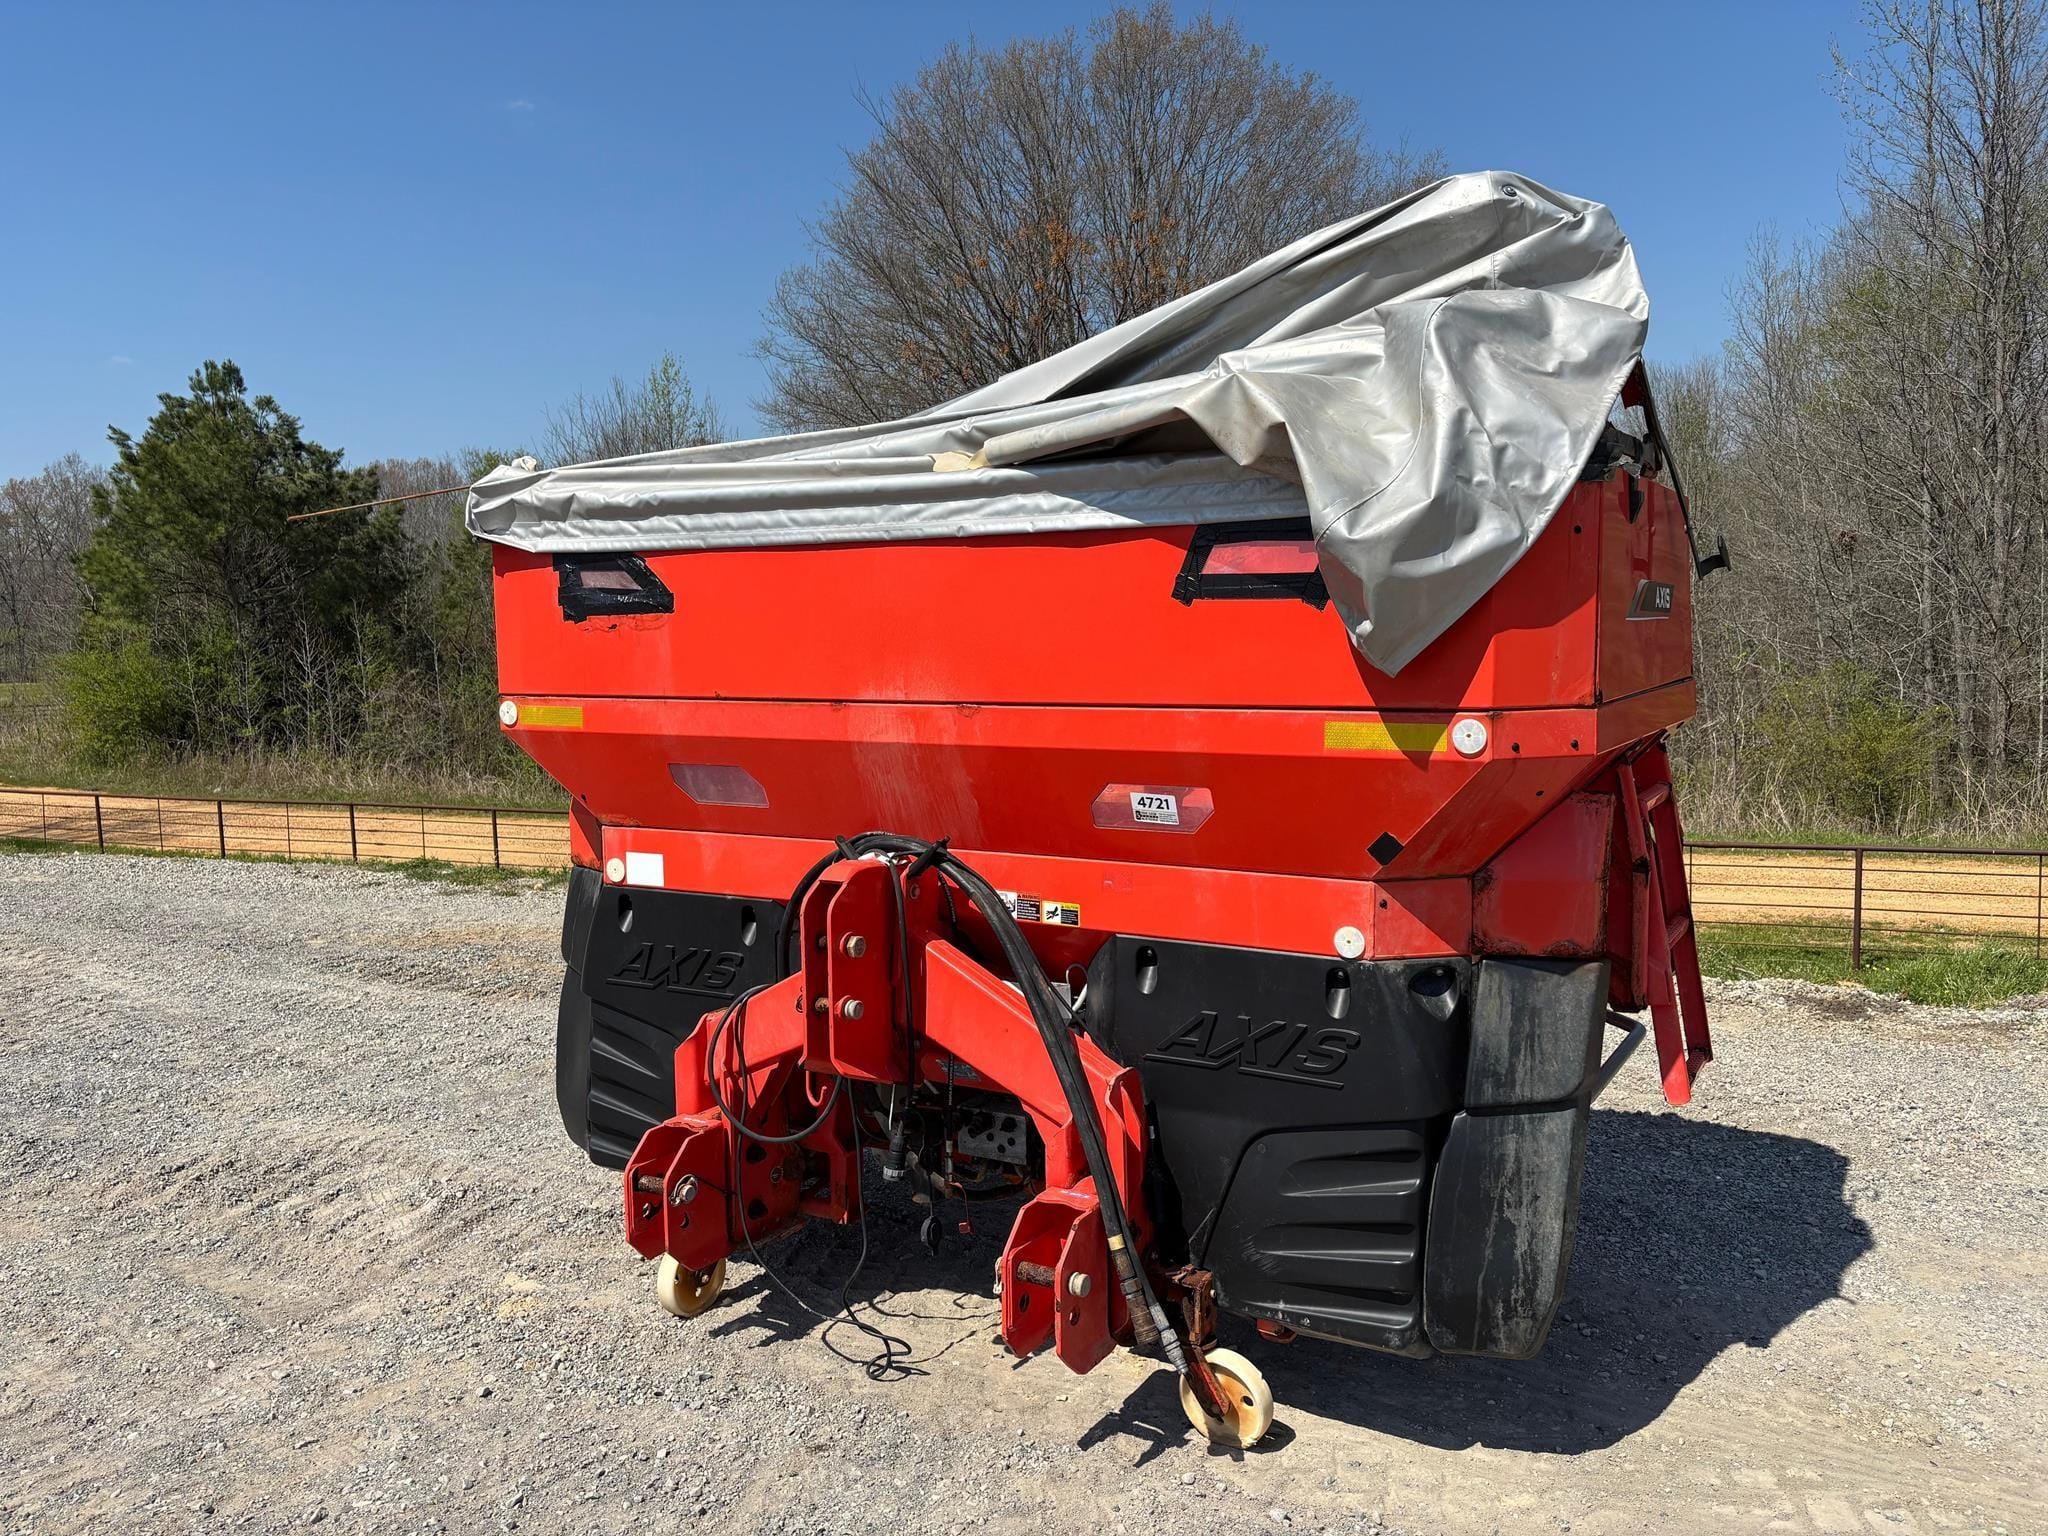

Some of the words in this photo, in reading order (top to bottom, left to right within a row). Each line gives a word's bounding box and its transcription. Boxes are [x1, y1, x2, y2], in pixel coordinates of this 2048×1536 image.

[1137, 796, 1170, 810] 4721
[613, 942, 744, 990] AXIS
[1155, 1010, 1361, 1075] AXIS
